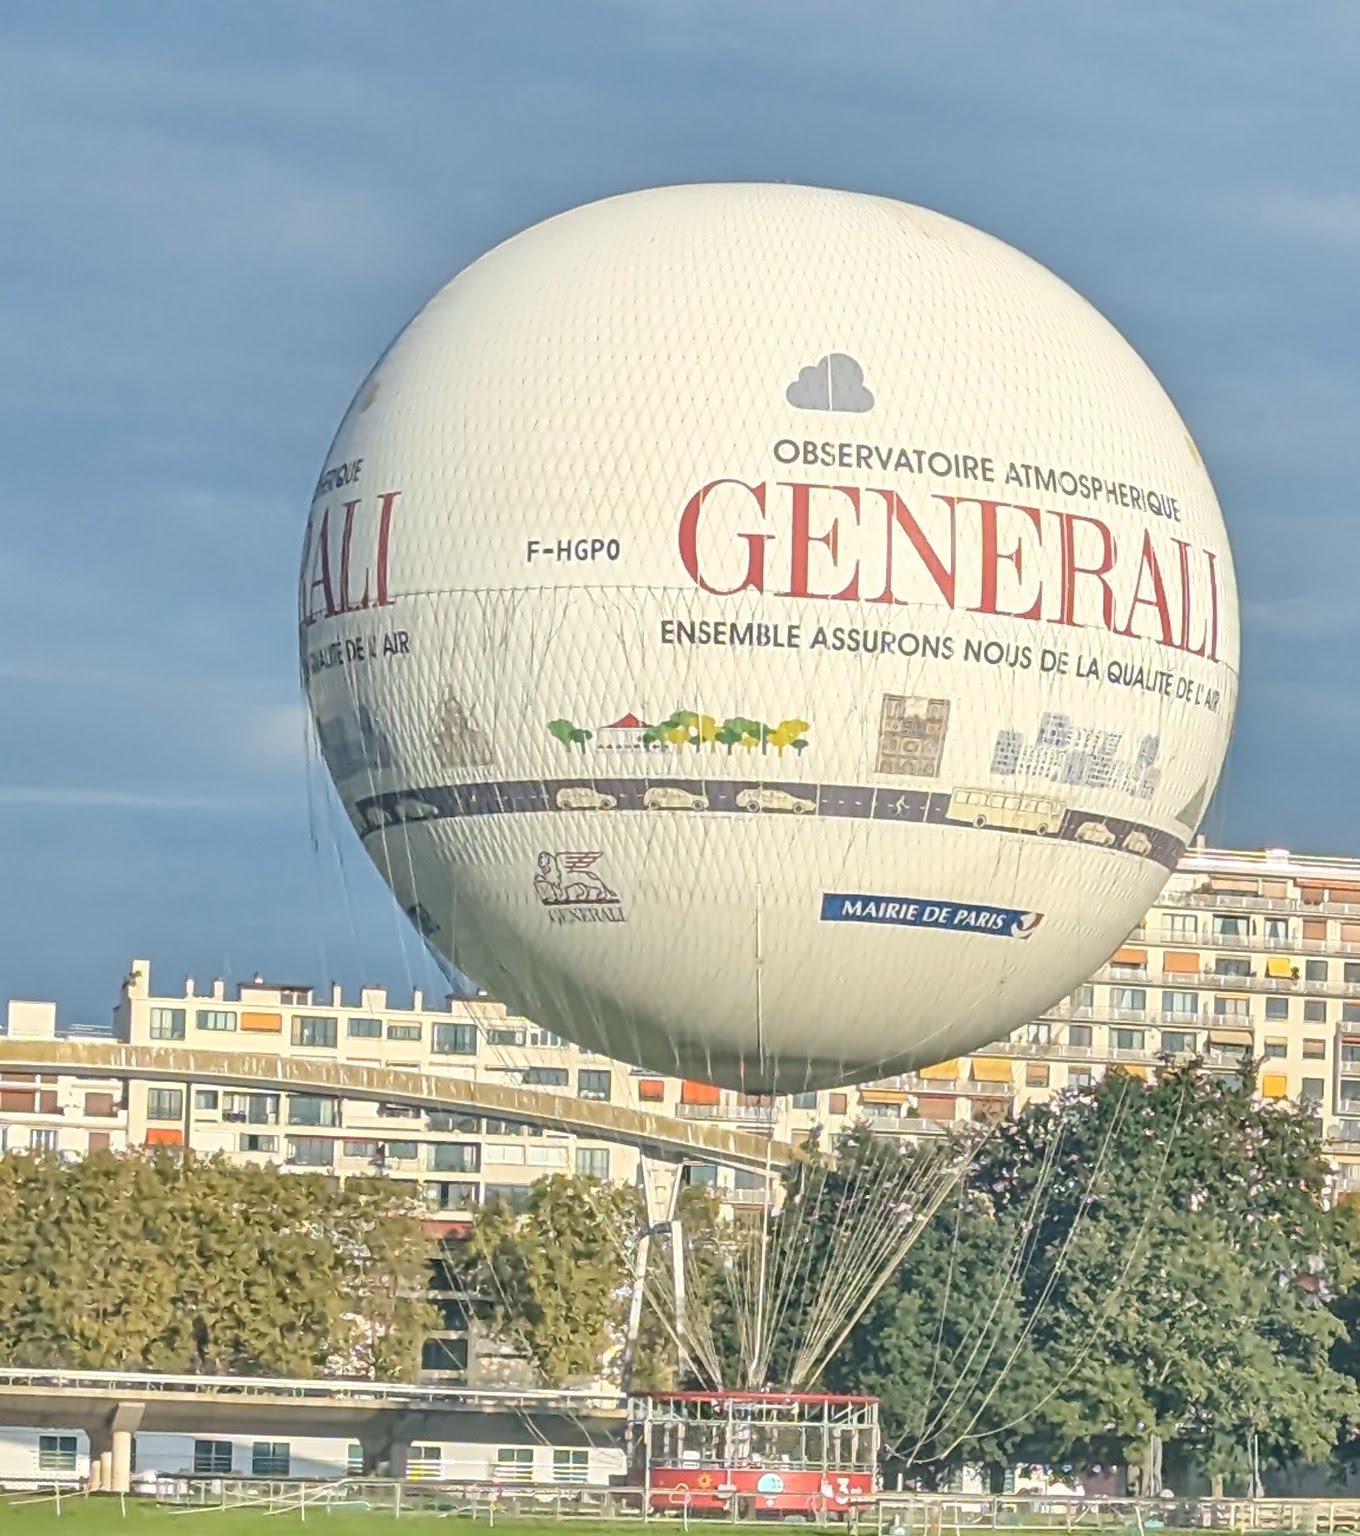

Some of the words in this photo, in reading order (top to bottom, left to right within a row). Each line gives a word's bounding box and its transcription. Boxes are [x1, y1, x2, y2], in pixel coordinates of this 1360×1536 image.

[773, 438, 995, 483] OBSERVATOIRE
[1004, 460, 1182, 522] ATMOSPHERIQUE
[678, 478, 1221, 662] GENERALI
[383, 630, 410, 657] AIR
[660, 619, 801, 649] ENSEMBLE
[810, 626, 955, 660] ASSURONS
[964, 638, 1033, 670] NOUS
[1040, 649, 1070, 675] DE
[1076, 655, 1100, 681] LA
[1176, 676, 1195, 703] DE
[842, 900, 919, 921] MAIRIE
[922, 905, 953, 925] DE
[953, 909, 1007, 931] PARIS
